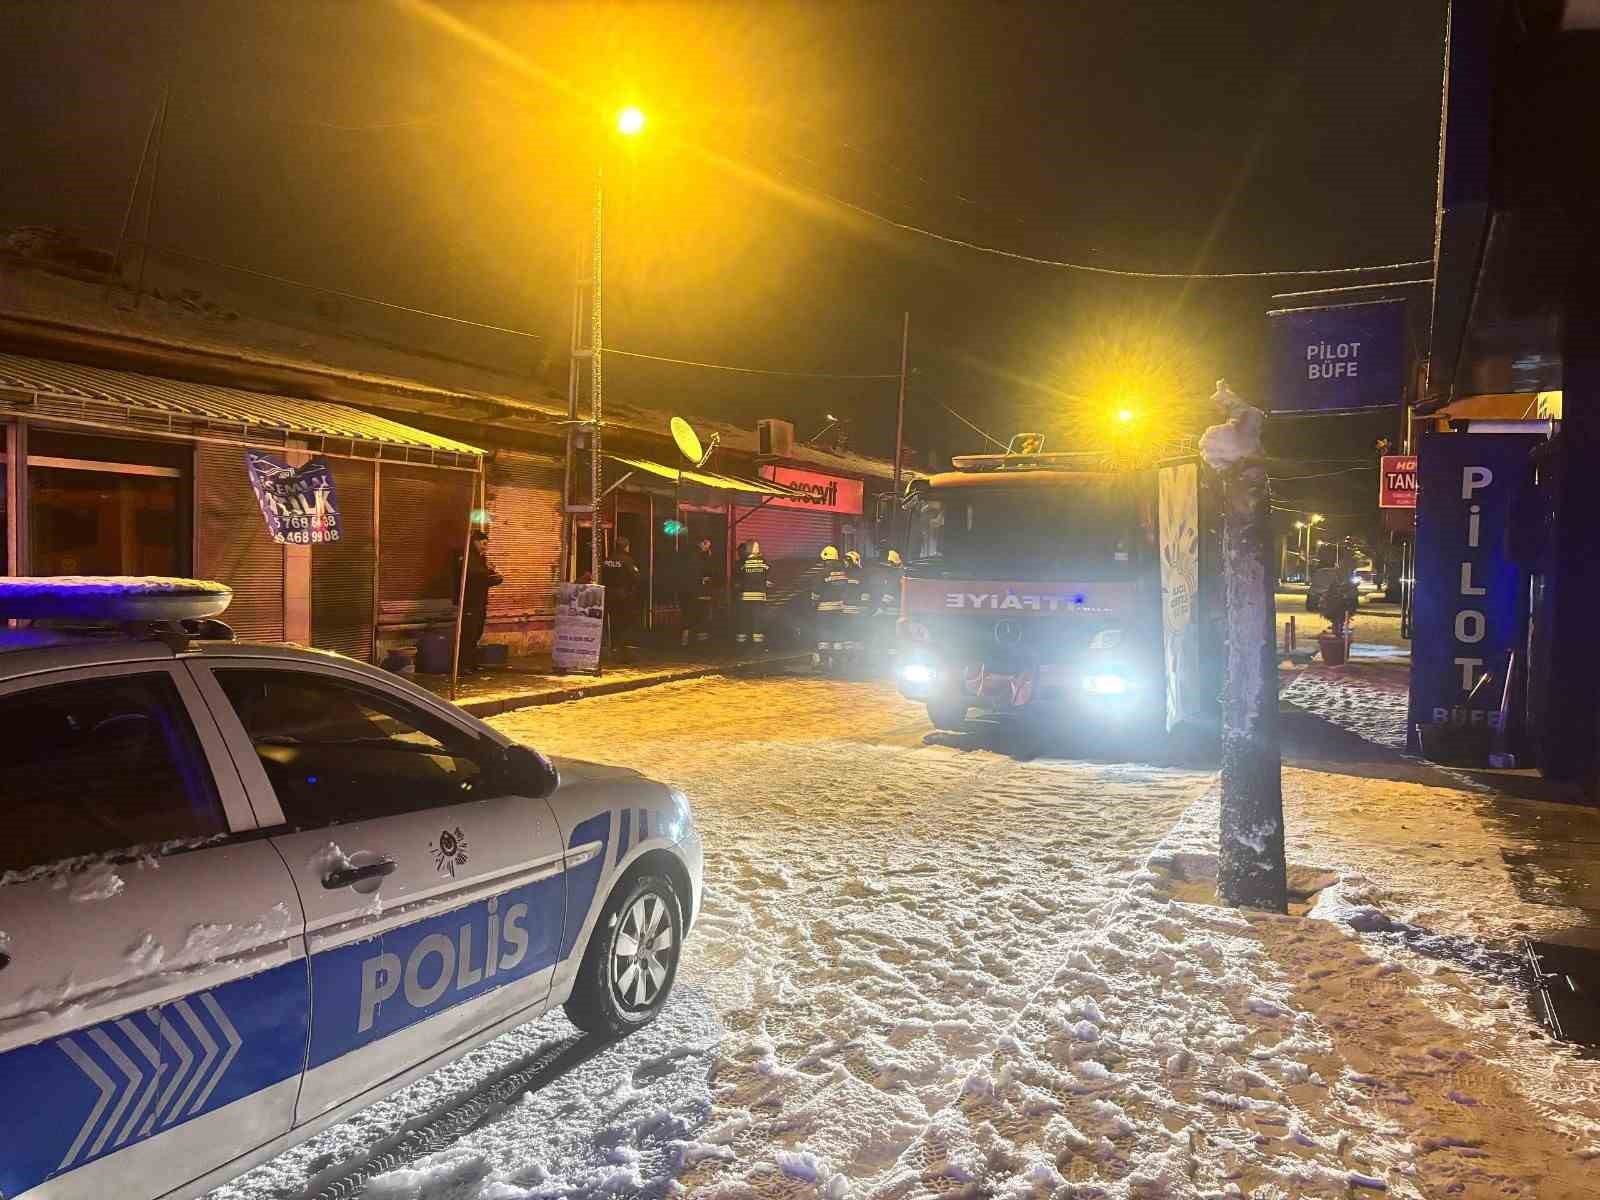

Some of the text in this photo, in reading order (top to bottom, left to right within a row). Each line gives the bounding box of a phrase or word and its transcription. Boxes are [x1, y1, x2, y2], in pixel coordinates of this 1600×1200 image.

[1306, 341, 1360, 360] PİLOT
[1308, 360, 1358, 379] BÜFE
[286, 531, 309, 543] 468
[1454, 465, 1493, 691] PİLOT
[1433, 706, 1504, 728] BÜFE
[357, 895, 529, 1034] POLİS
